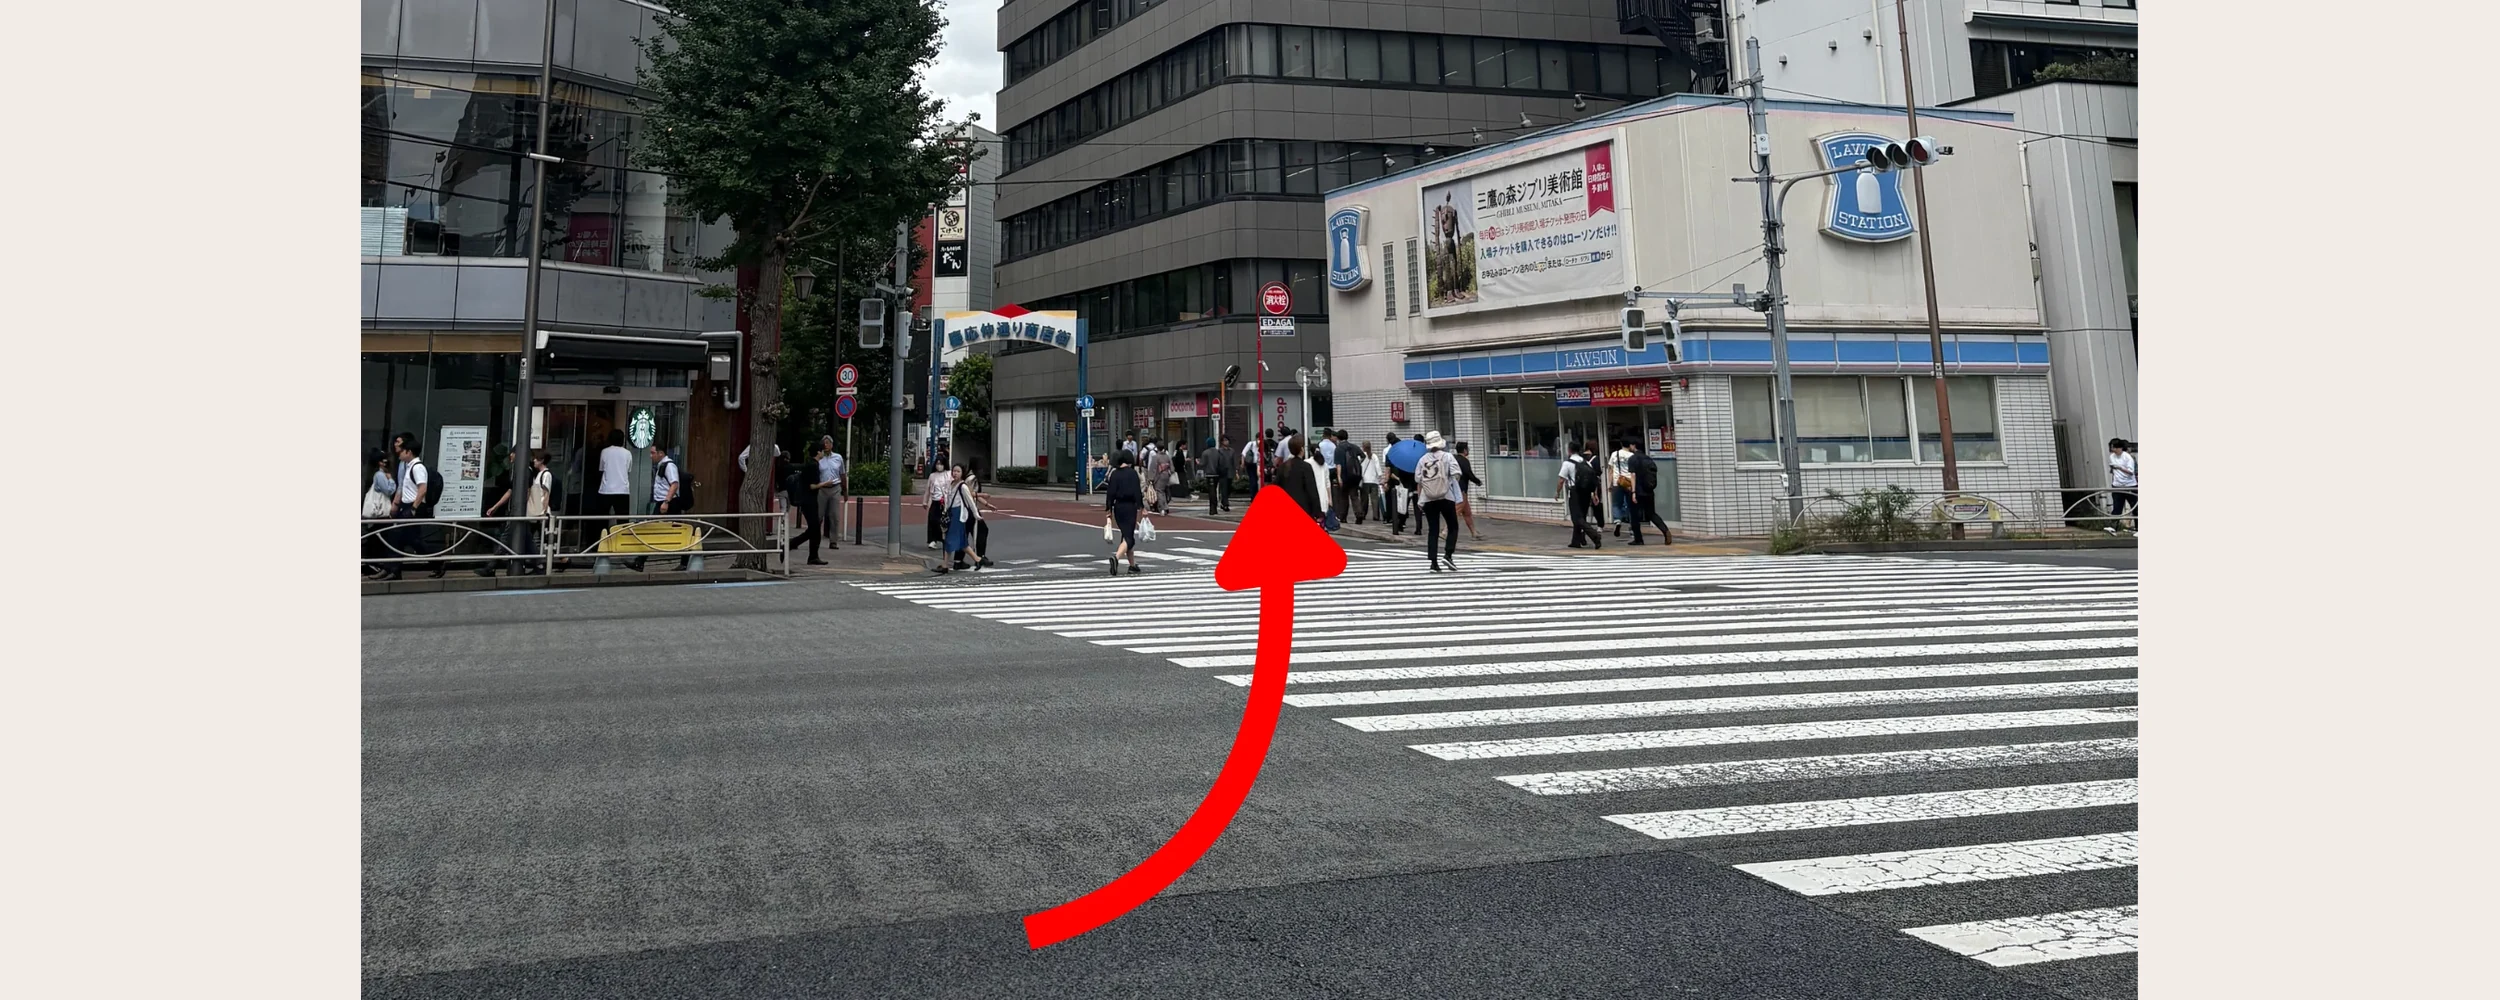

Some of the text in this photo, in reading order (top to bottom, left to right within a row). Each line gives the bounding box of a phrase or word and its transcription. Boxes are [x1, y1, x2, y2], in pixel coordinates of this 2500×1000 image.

[1831, 143, 1872, 159] LAW
[1477, 167, 1583, 211] 三鷹の森ジブリ美術館
[1496, 197, 1563, 218] GHIBLI MUSEUM, MITAKA
[1331, 215, 1357, 230] LAWSON
[1838, 211, 1905, 229] STATION
[1480, 224, 1617, 260] 入場チケットを購入できるのはローソンだけ!!
[942, 251, 962, 270] だん
[1332, 267, 1359, 281] STATION
[1265, 294, 1287, 305] 消火栓
[1565, 349, 1618, 368] LAWSON
[842, 370, 853, 381] 30
[1171, 400, 1194, 412] docomo
[1277, 397, 1287, 441] docom
